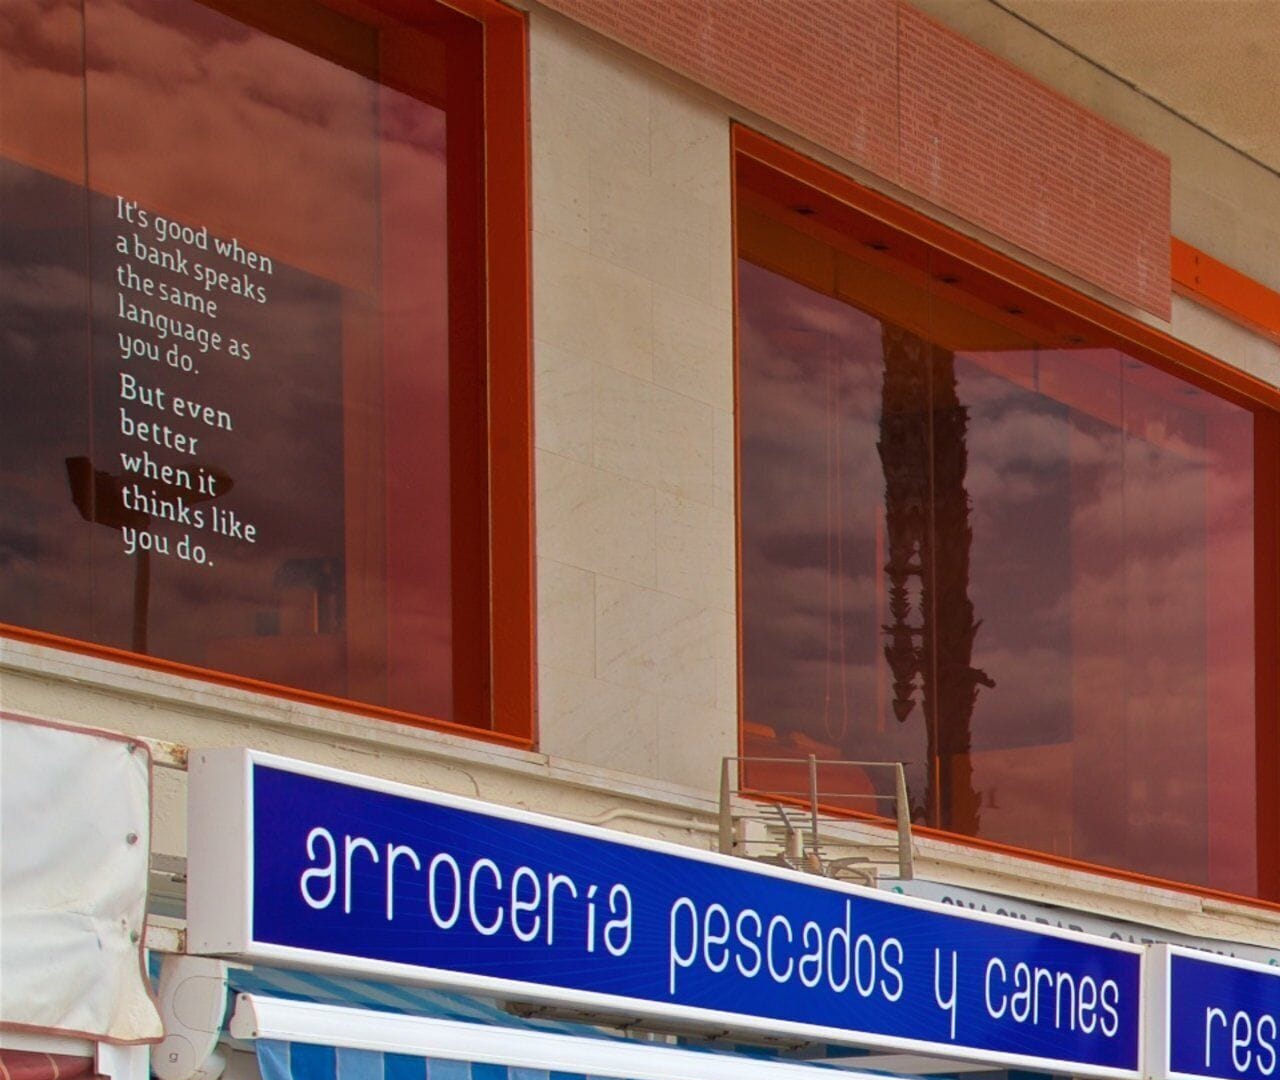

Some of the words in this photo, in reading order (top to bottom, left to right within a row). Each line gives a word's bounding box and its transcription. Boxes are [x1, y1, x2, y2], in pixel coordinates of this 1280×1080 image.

[117, 195, 148, 228] It's
[155, 216, 208, 250] good
[214, 238, 273, 275] when
[116, 235, 129, 255] a
[134, 233, 189, 275] bank
[194, 263, 267, 303] speaks
[116, 264, 154, 296] the
[159, 283, 218, 318] same
[118, 293, 222, 353] language
[228, 339, 251, 360] as
[118, 333, 160, 359] you
[167, 344, 199, 374] do.
[120, 373, 165, 410] But
[173, 397, 232, 431] even
[120, 408, 198, 455] better
[120, 451, 191, 490] when
[199, 468, 216, 497] it
[122, 484, 204, 529] thinks
[212, 506, 256, 543] like
[122, 526, 169, 554] you
[177, 534, 213, 566] do.
[301, 825, 632, 956] arrocería
[670, 899, 904, 1003] pescados
[934, 949, 957, 1039] y
[985, 956, 1119, 1038] carnes
